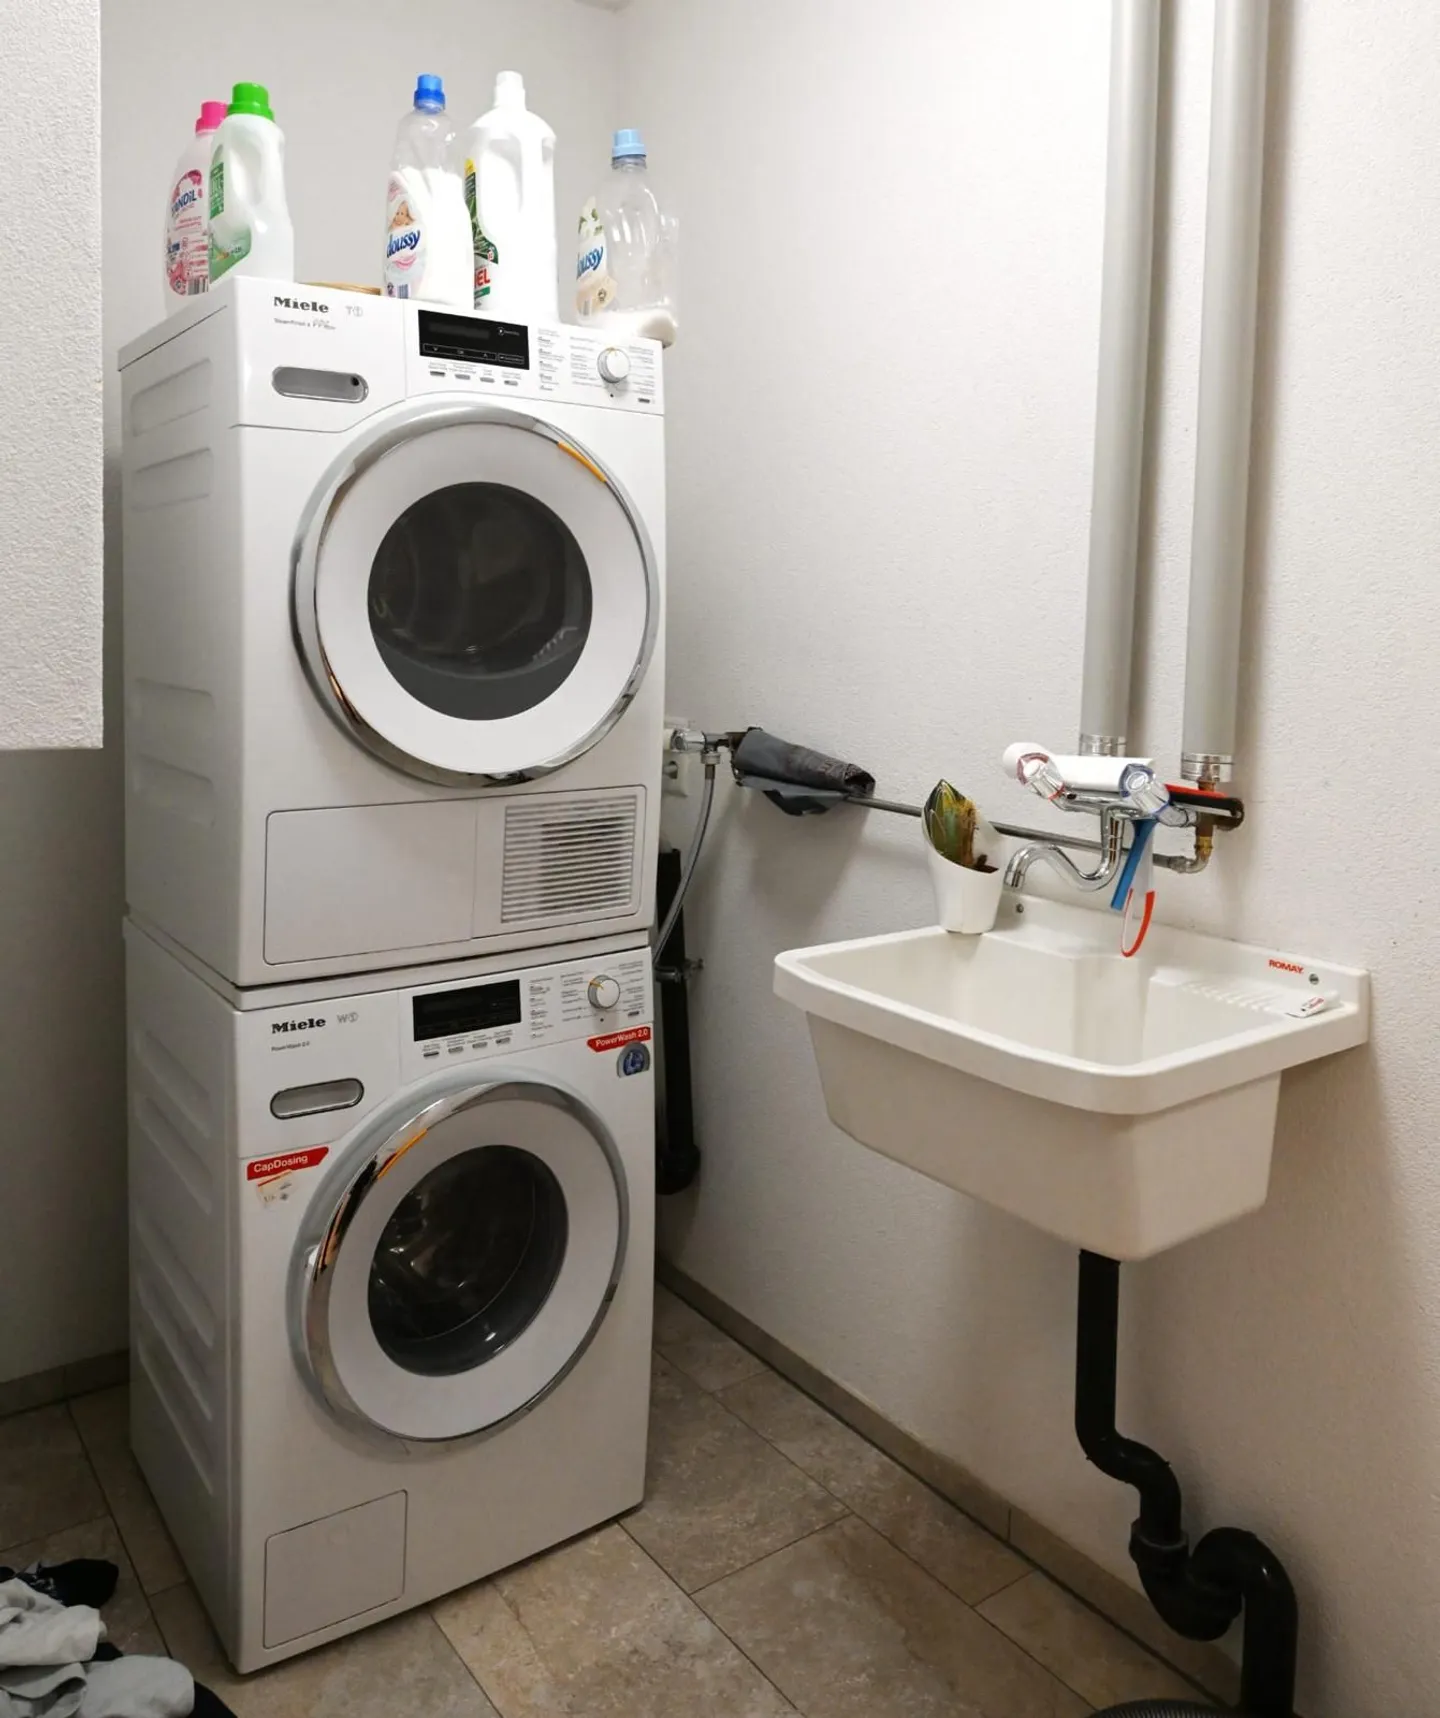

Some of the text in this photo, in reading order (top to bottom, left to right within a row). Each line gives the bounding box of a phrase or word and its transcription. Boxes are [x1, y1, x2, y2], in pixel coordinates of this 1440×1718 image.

[274, 296, 329, 313] Miele
[1268, 959, 1304, 974] ROMAY
[272, 1018, 327, 1034] Miele
[594, 1028, 649, 1048] PowerWash 2.0
[253, 1155, 309, 1173] CapDosing
